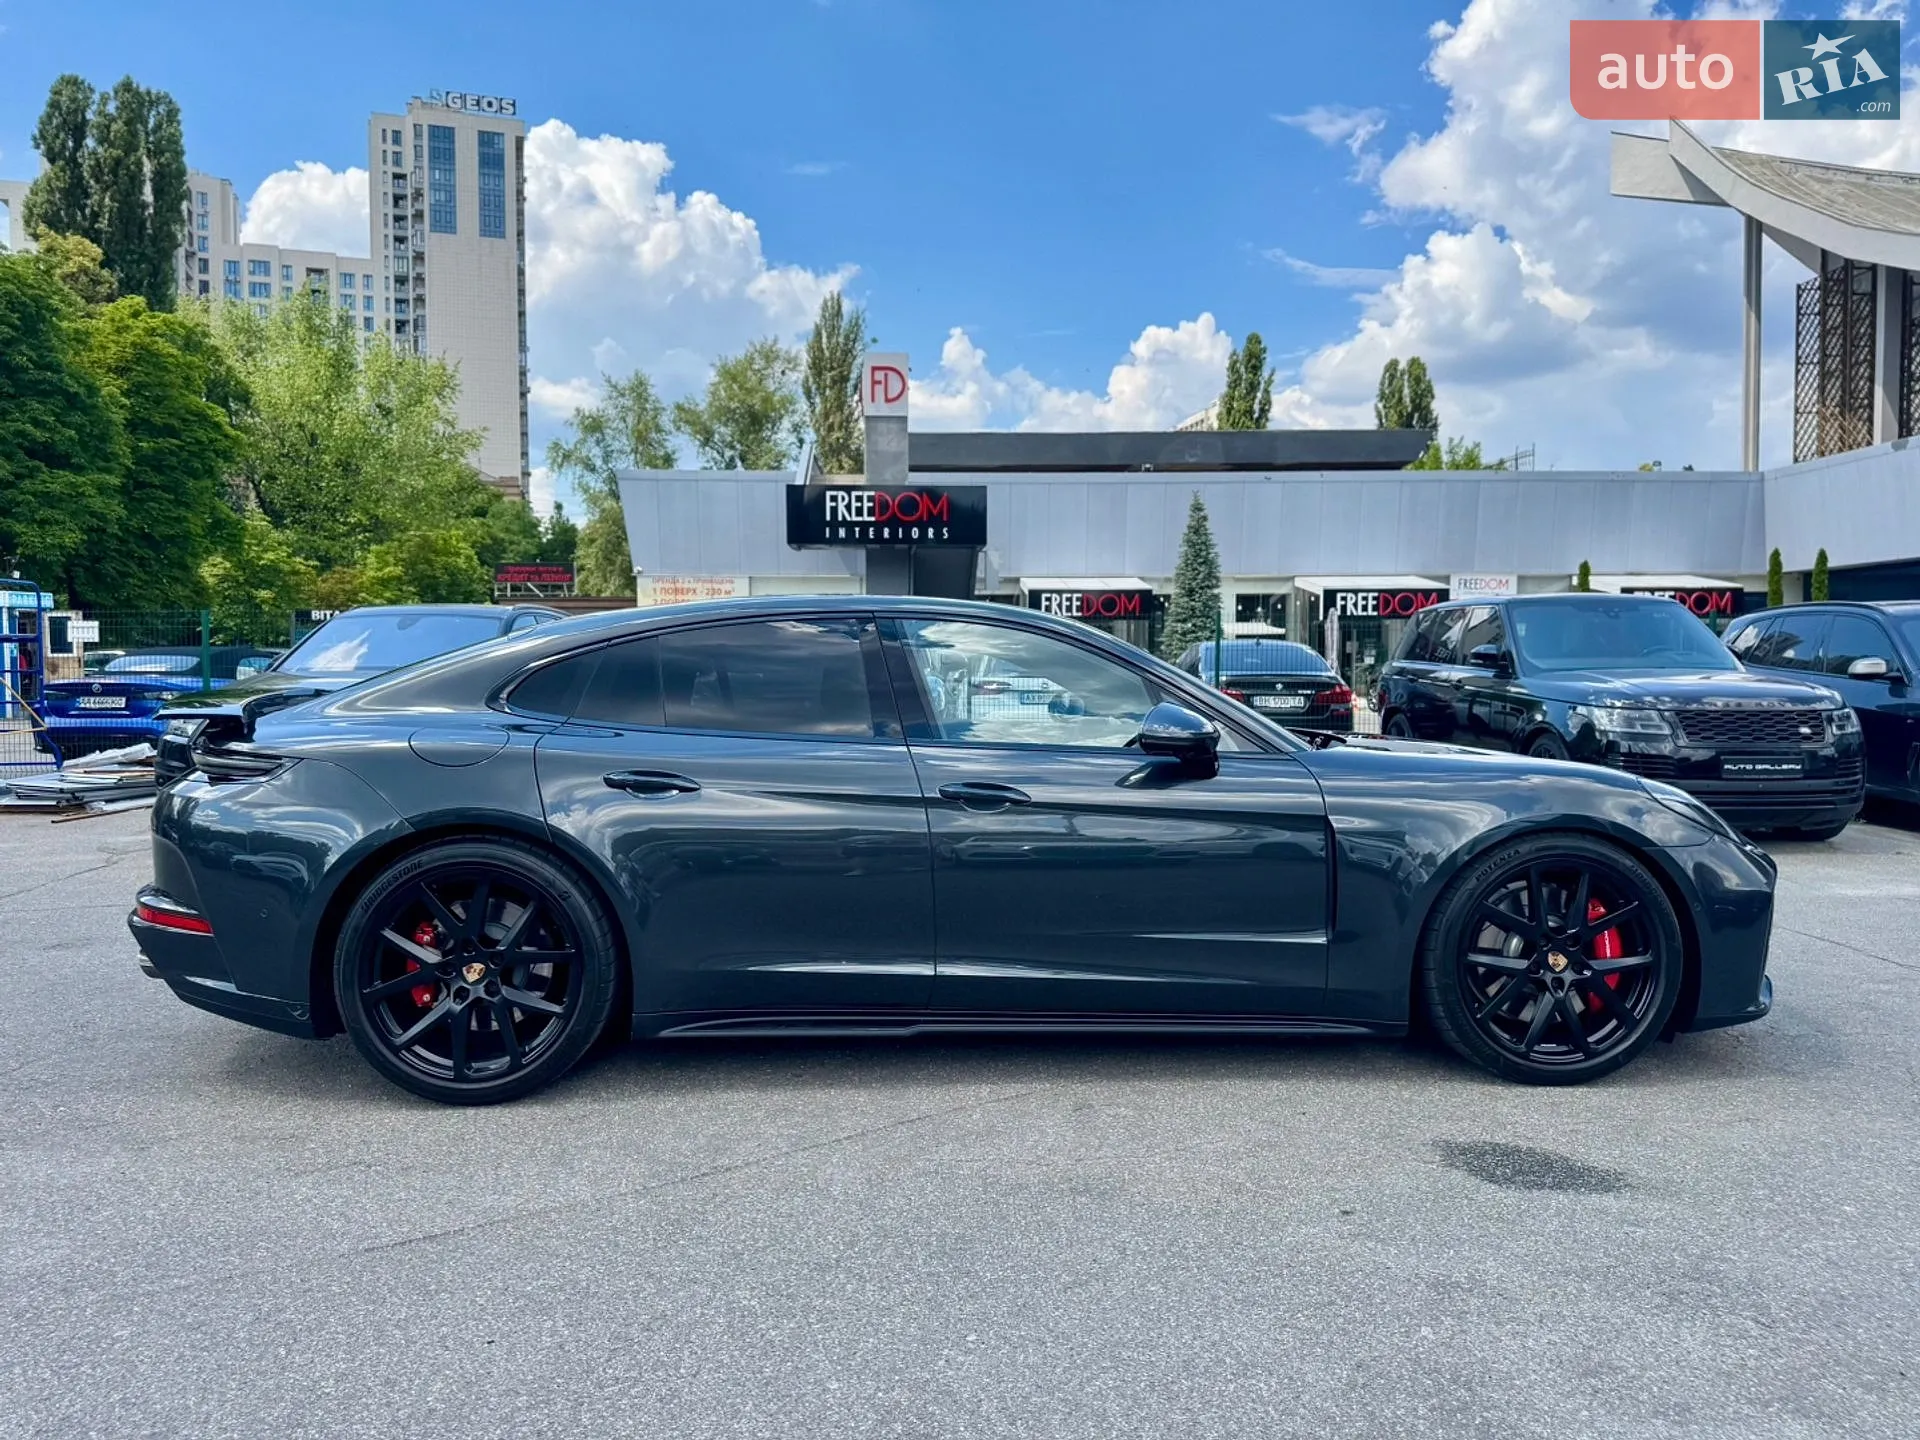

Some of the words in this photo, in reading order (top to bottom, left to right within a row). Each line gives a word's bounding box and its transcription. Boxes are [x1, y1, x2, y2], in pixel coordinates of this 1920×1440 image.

[446, 91, 516, 115] GEOS
[870, 365, 906, 403] FD
[825, 491, 949, 521] FREEDOM
[825, 527, 949, 539] INTERIORS
[1457, 577, 1509, 591] FREEDOM
[1041, 593, 1141, 616] FREEDOM
